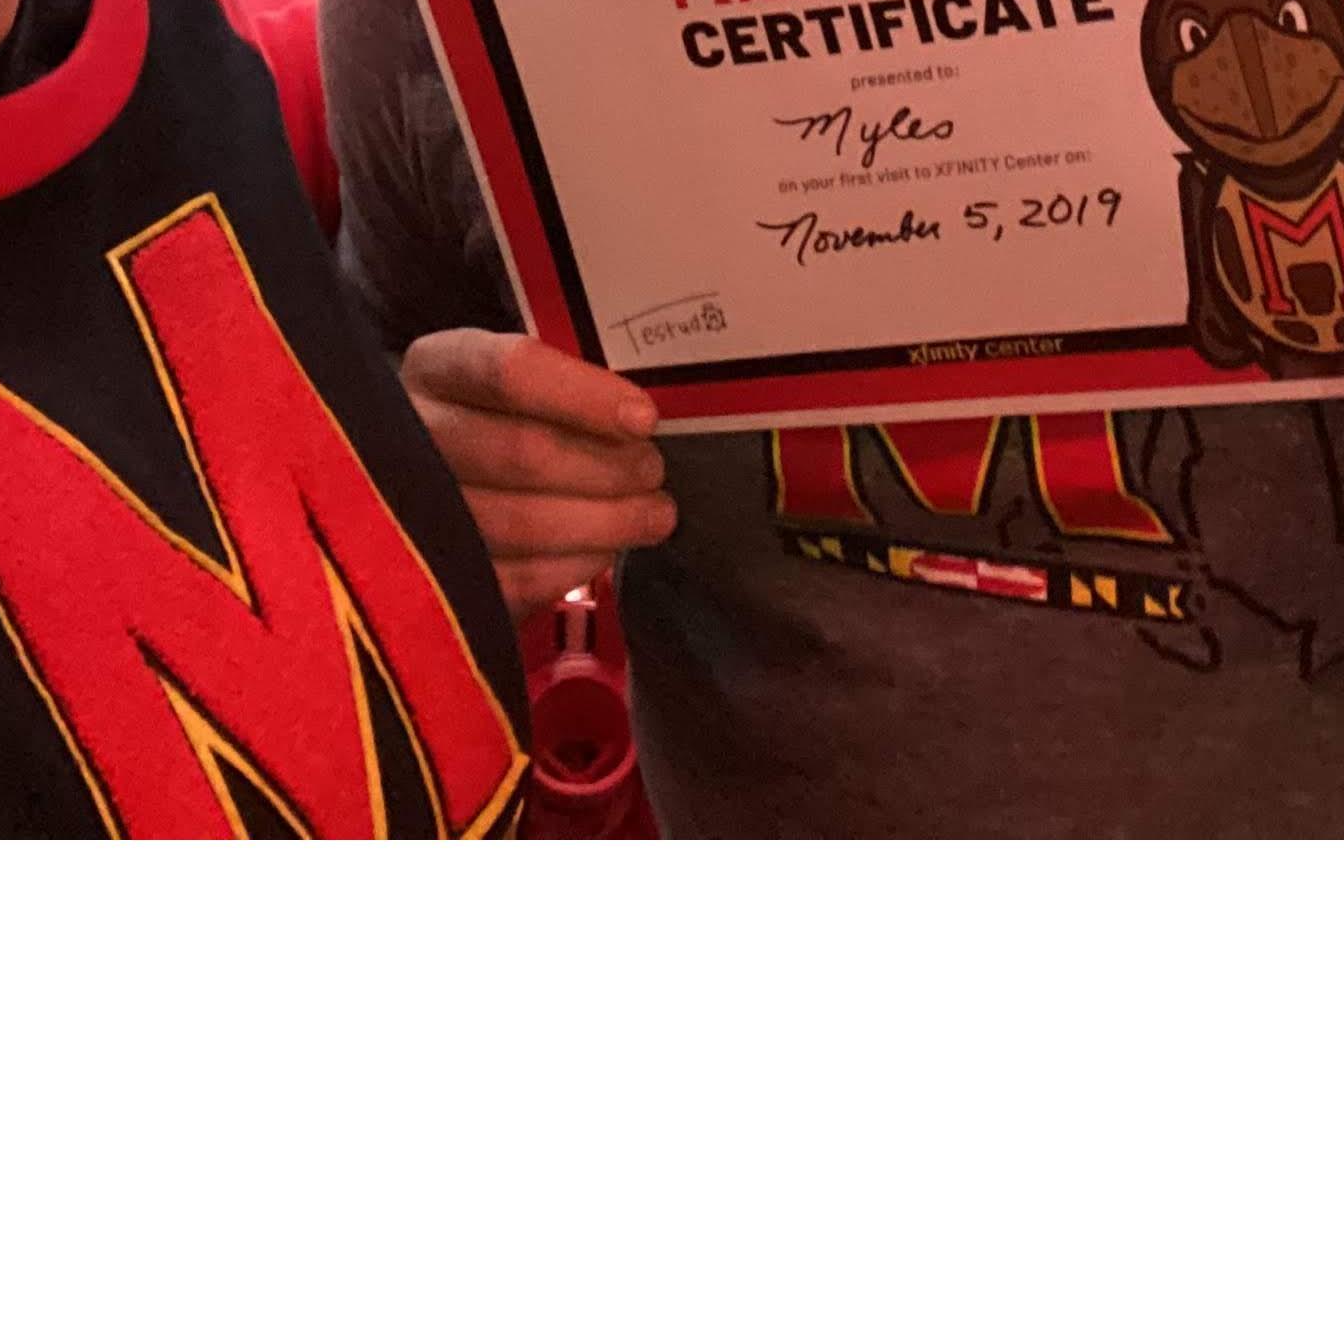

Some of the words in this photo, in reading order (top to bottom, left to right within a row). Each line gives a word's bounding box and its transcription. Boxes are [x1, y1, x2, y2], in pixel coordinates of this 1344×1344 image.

[850, 69, 933, 92] presented
[937, 65, 960, 81] to:
[773, 106, 955, 169] Myles
[778, 179, 798, 193] on
[801, 177, 834, 194] your
[840, 170, 873, 187] first
[877, 167, 910, 184] visit
[914, 165, 931, 179] to
[935, 158, 1000, 178] XFINITY
[1004, 152, 1060, 172] Center
[1065, 149, 1091, 164] on:
[756, 210, 941, 266] November
[963, 200, 1005, 242] 5,
[1019, 187, 1122, 229] 2019
[908, 341, 977, 366] xfinity
[984, 336, 1064, 358] center
